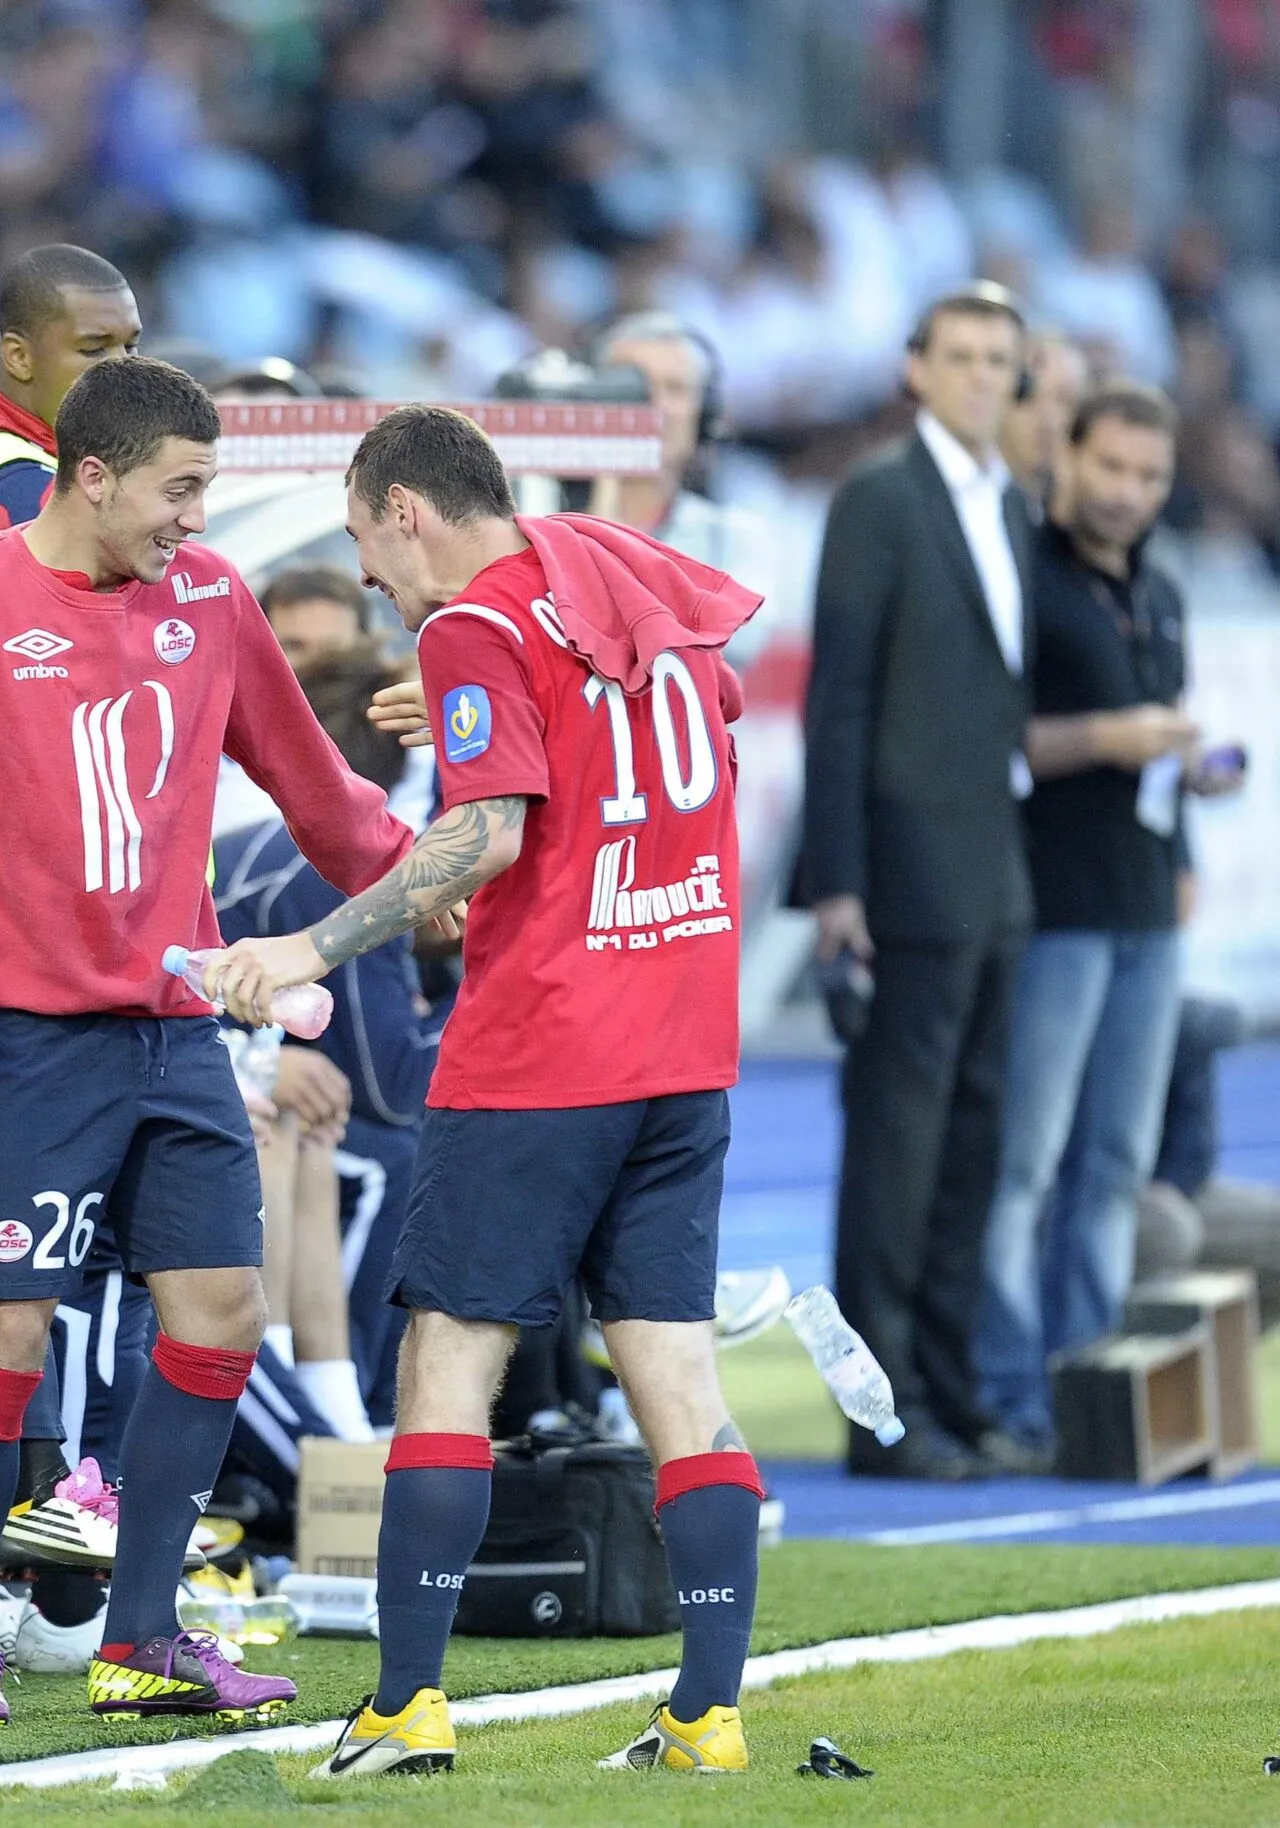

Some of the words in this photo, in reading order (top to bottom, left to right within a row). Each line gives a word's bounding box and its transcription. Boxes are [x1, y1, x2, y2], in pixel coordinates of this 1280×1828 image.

[161, 635, 193, 652] LOSC
[12, 661, 69, 681] umbro
[580, 648, 719, 828] 10
[628, 931, 659, 950] DU
[662, 915, 733, 943] POKER
[31, 1190, 105, 1270] 26
[678, 1587, 736, 1605] LOSC
